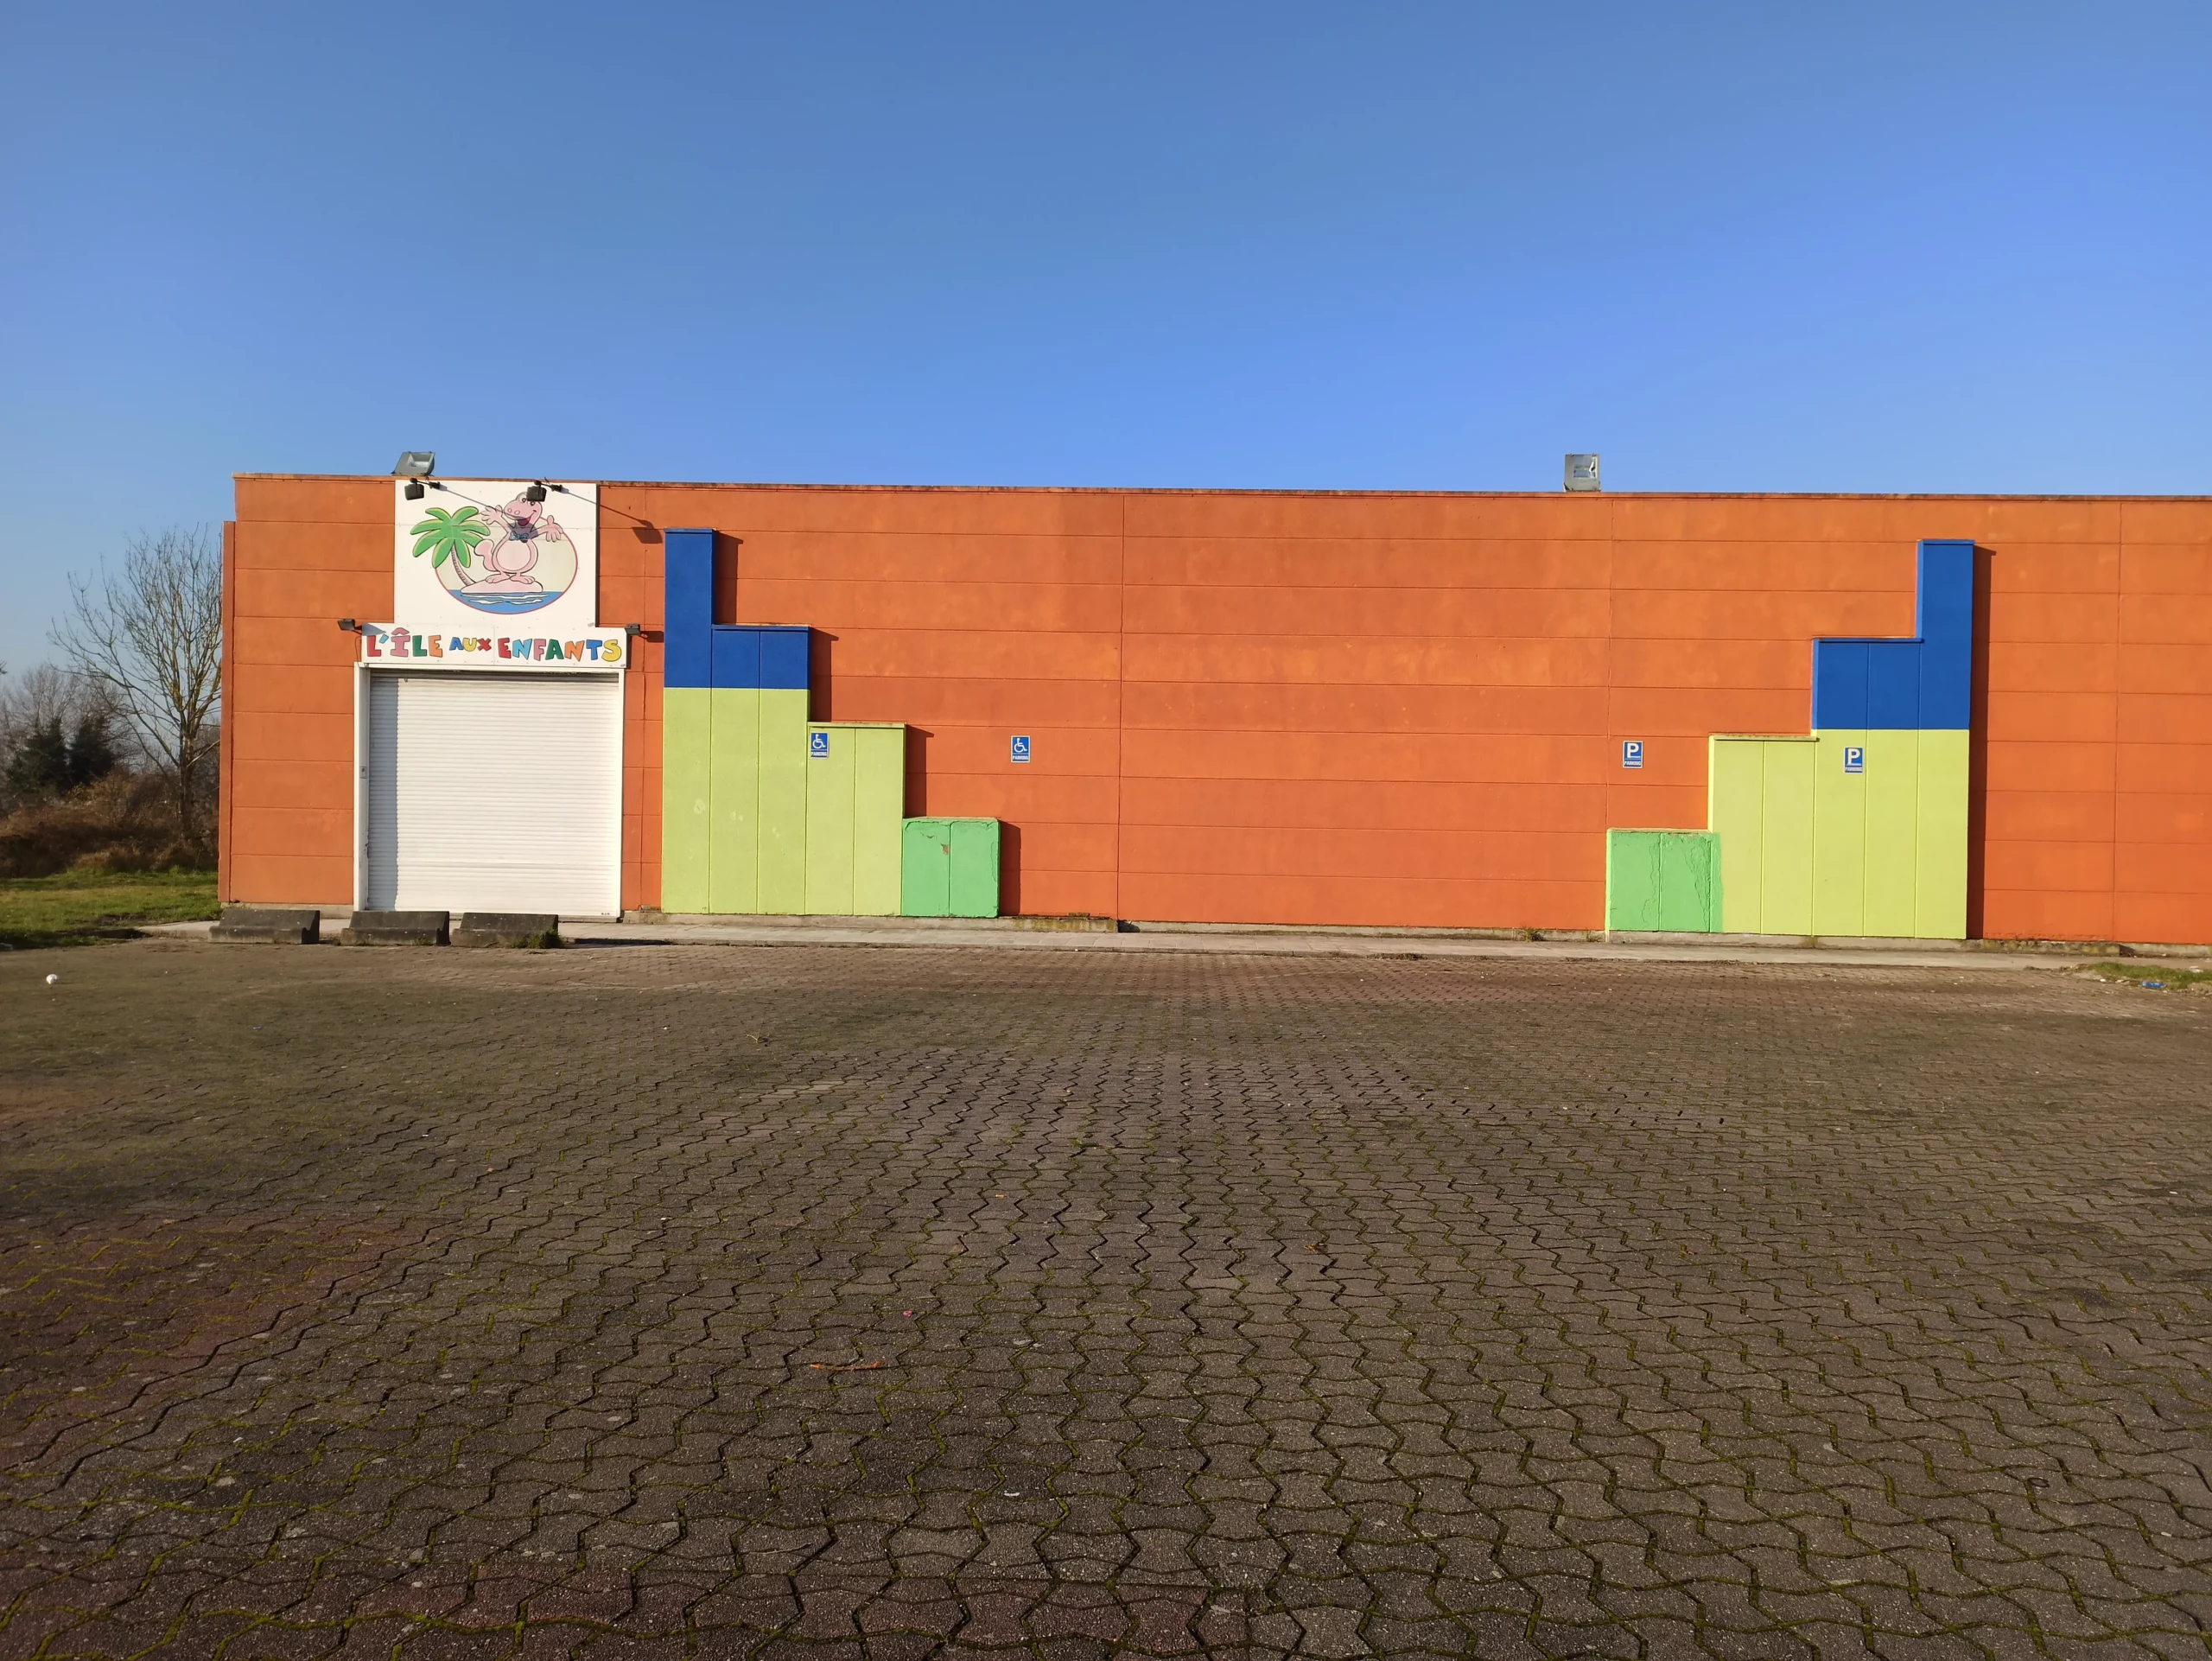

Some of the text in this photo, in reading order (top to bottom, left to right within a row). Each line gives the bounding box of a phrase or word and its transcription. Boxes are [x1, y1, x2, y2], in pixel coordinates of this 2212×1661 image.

[366, 627, 623, 662] L'ÎLE AUX ENFANTS
[1627, 742, 1639, 758] P
[1847, 748, 1860, 764] P
